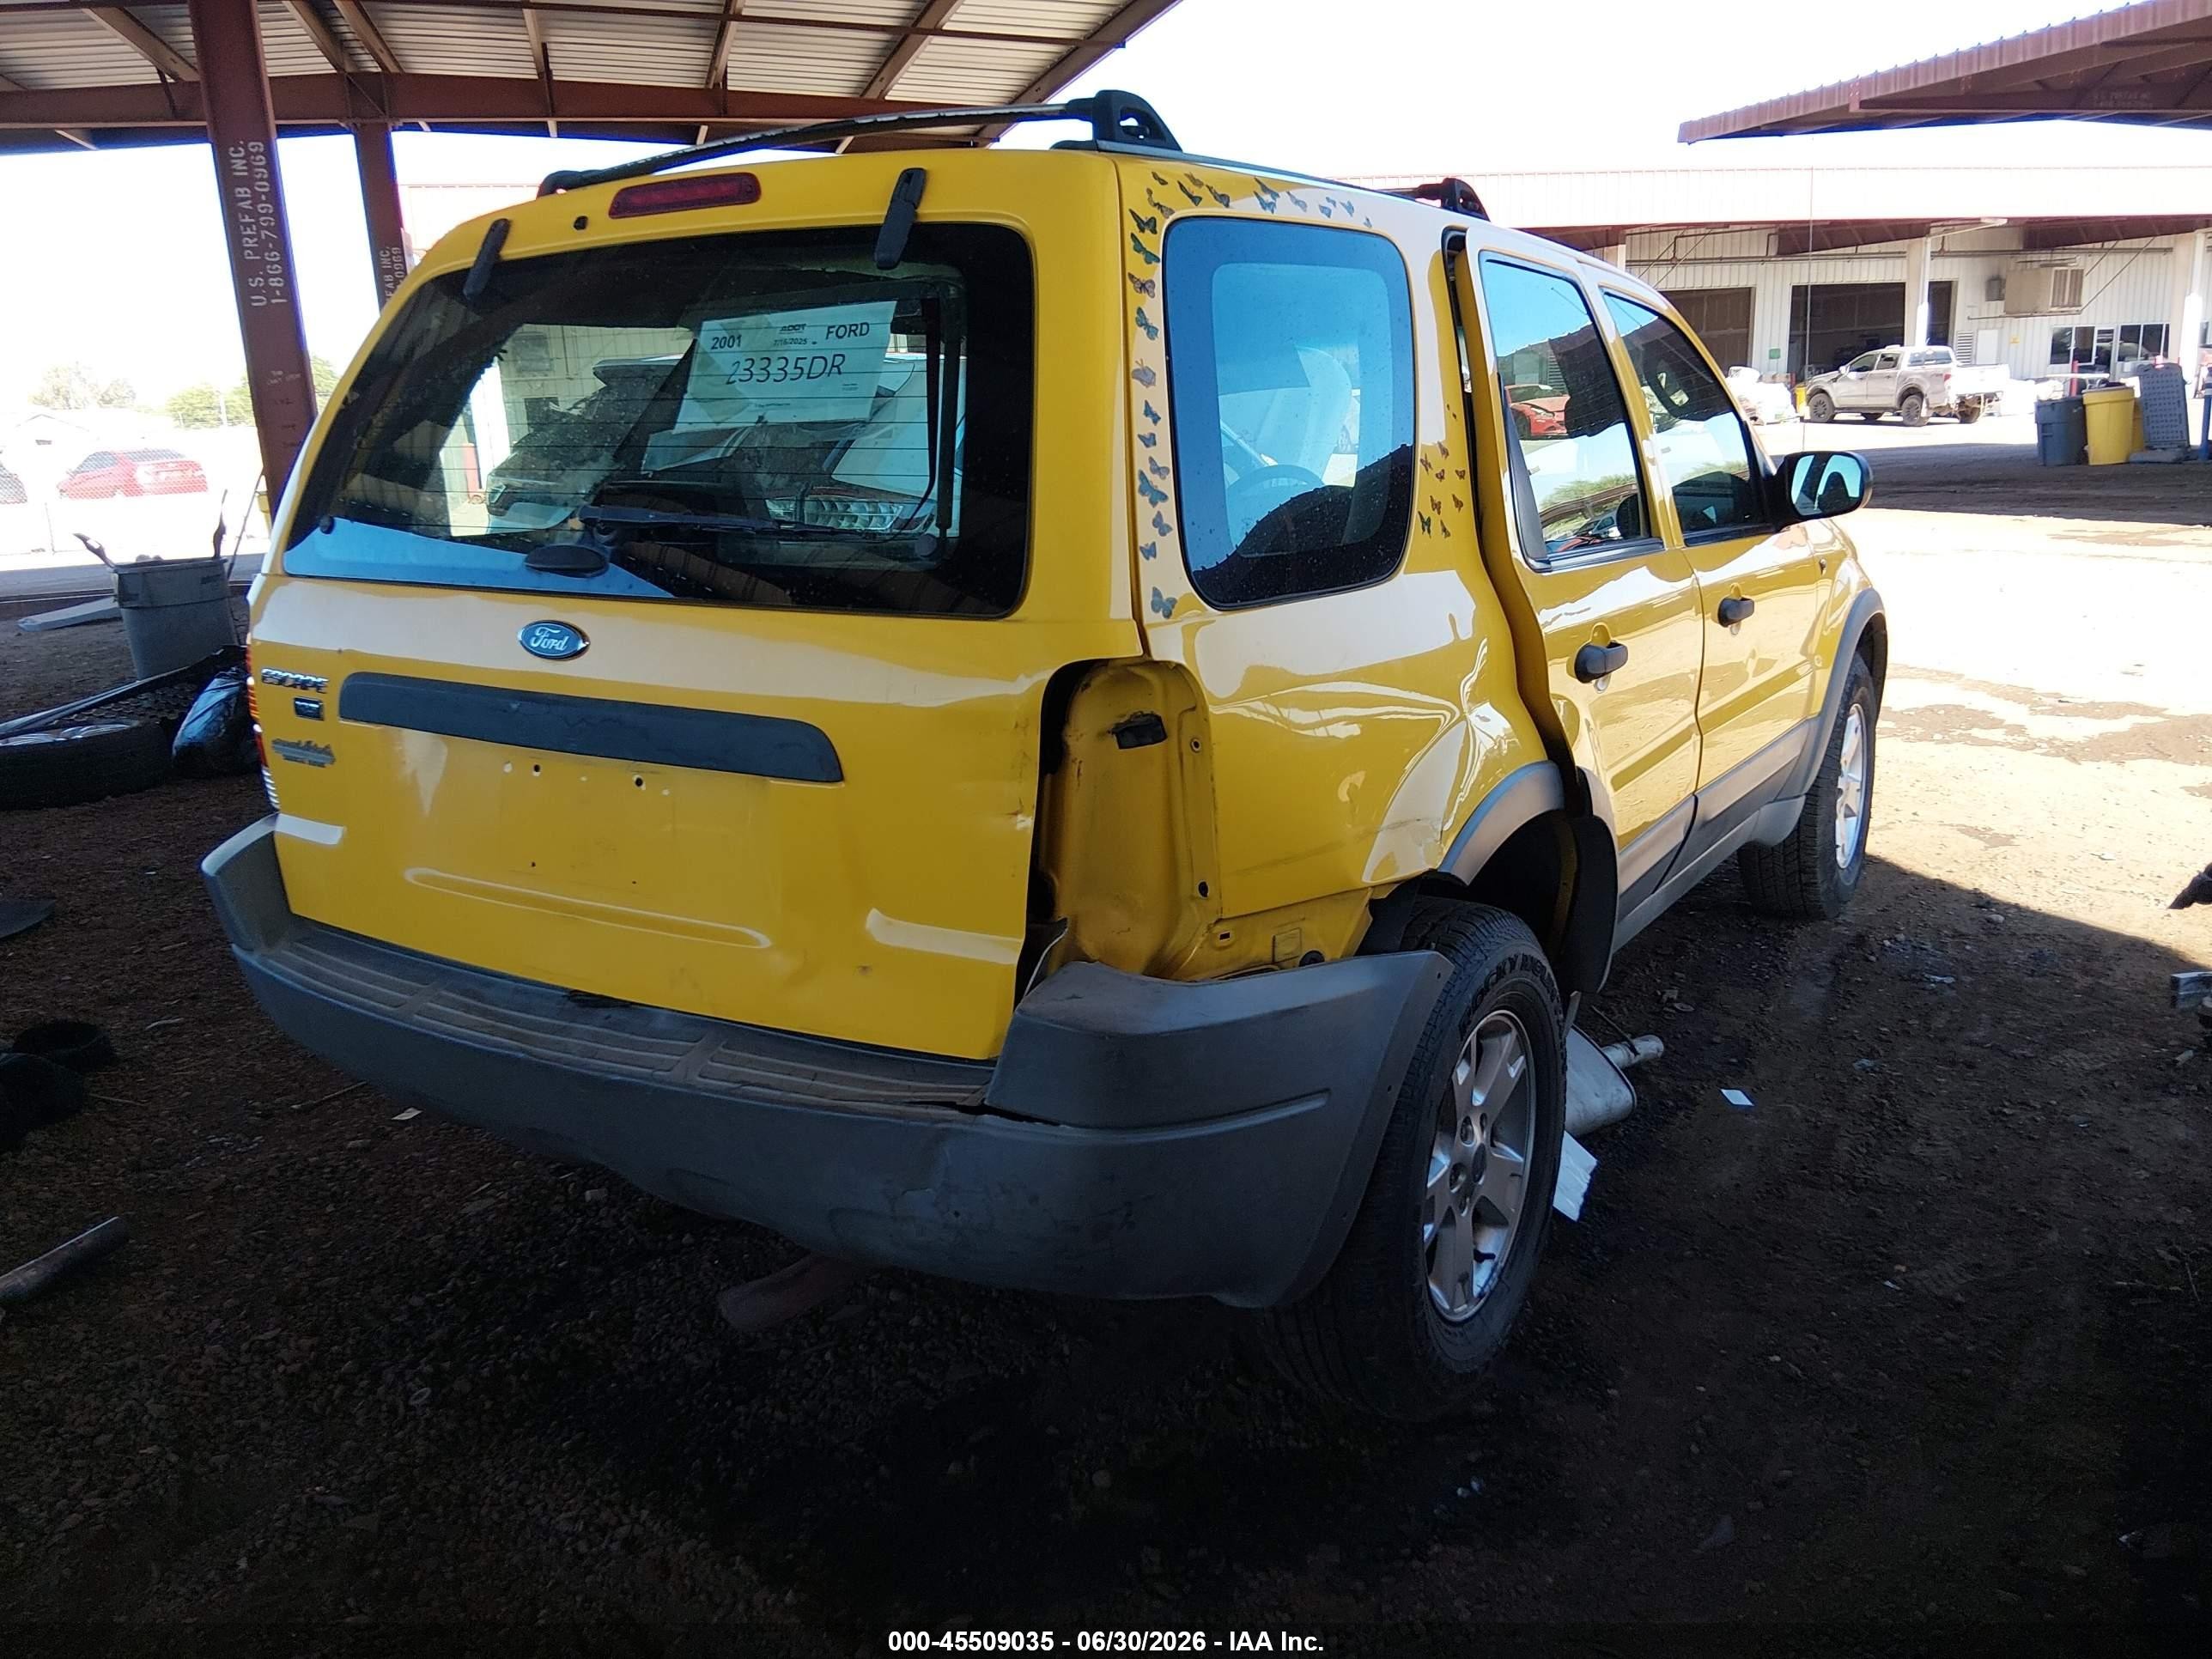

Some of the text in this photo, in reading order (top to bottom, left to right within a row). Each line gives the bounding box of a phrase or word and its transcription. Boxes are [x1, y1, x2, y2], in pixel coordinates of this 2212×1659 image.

[228, 141, 267, 307] U.S. PREFAB INC.
[249, 141, 288, 303] 1-866-799-0969
[711, 335, 742, 350] 2001
[825, 322, 870, 340] FORD
[725, 353, 846, 385] 23335DR
[529, 626, 570, 652] Ford
